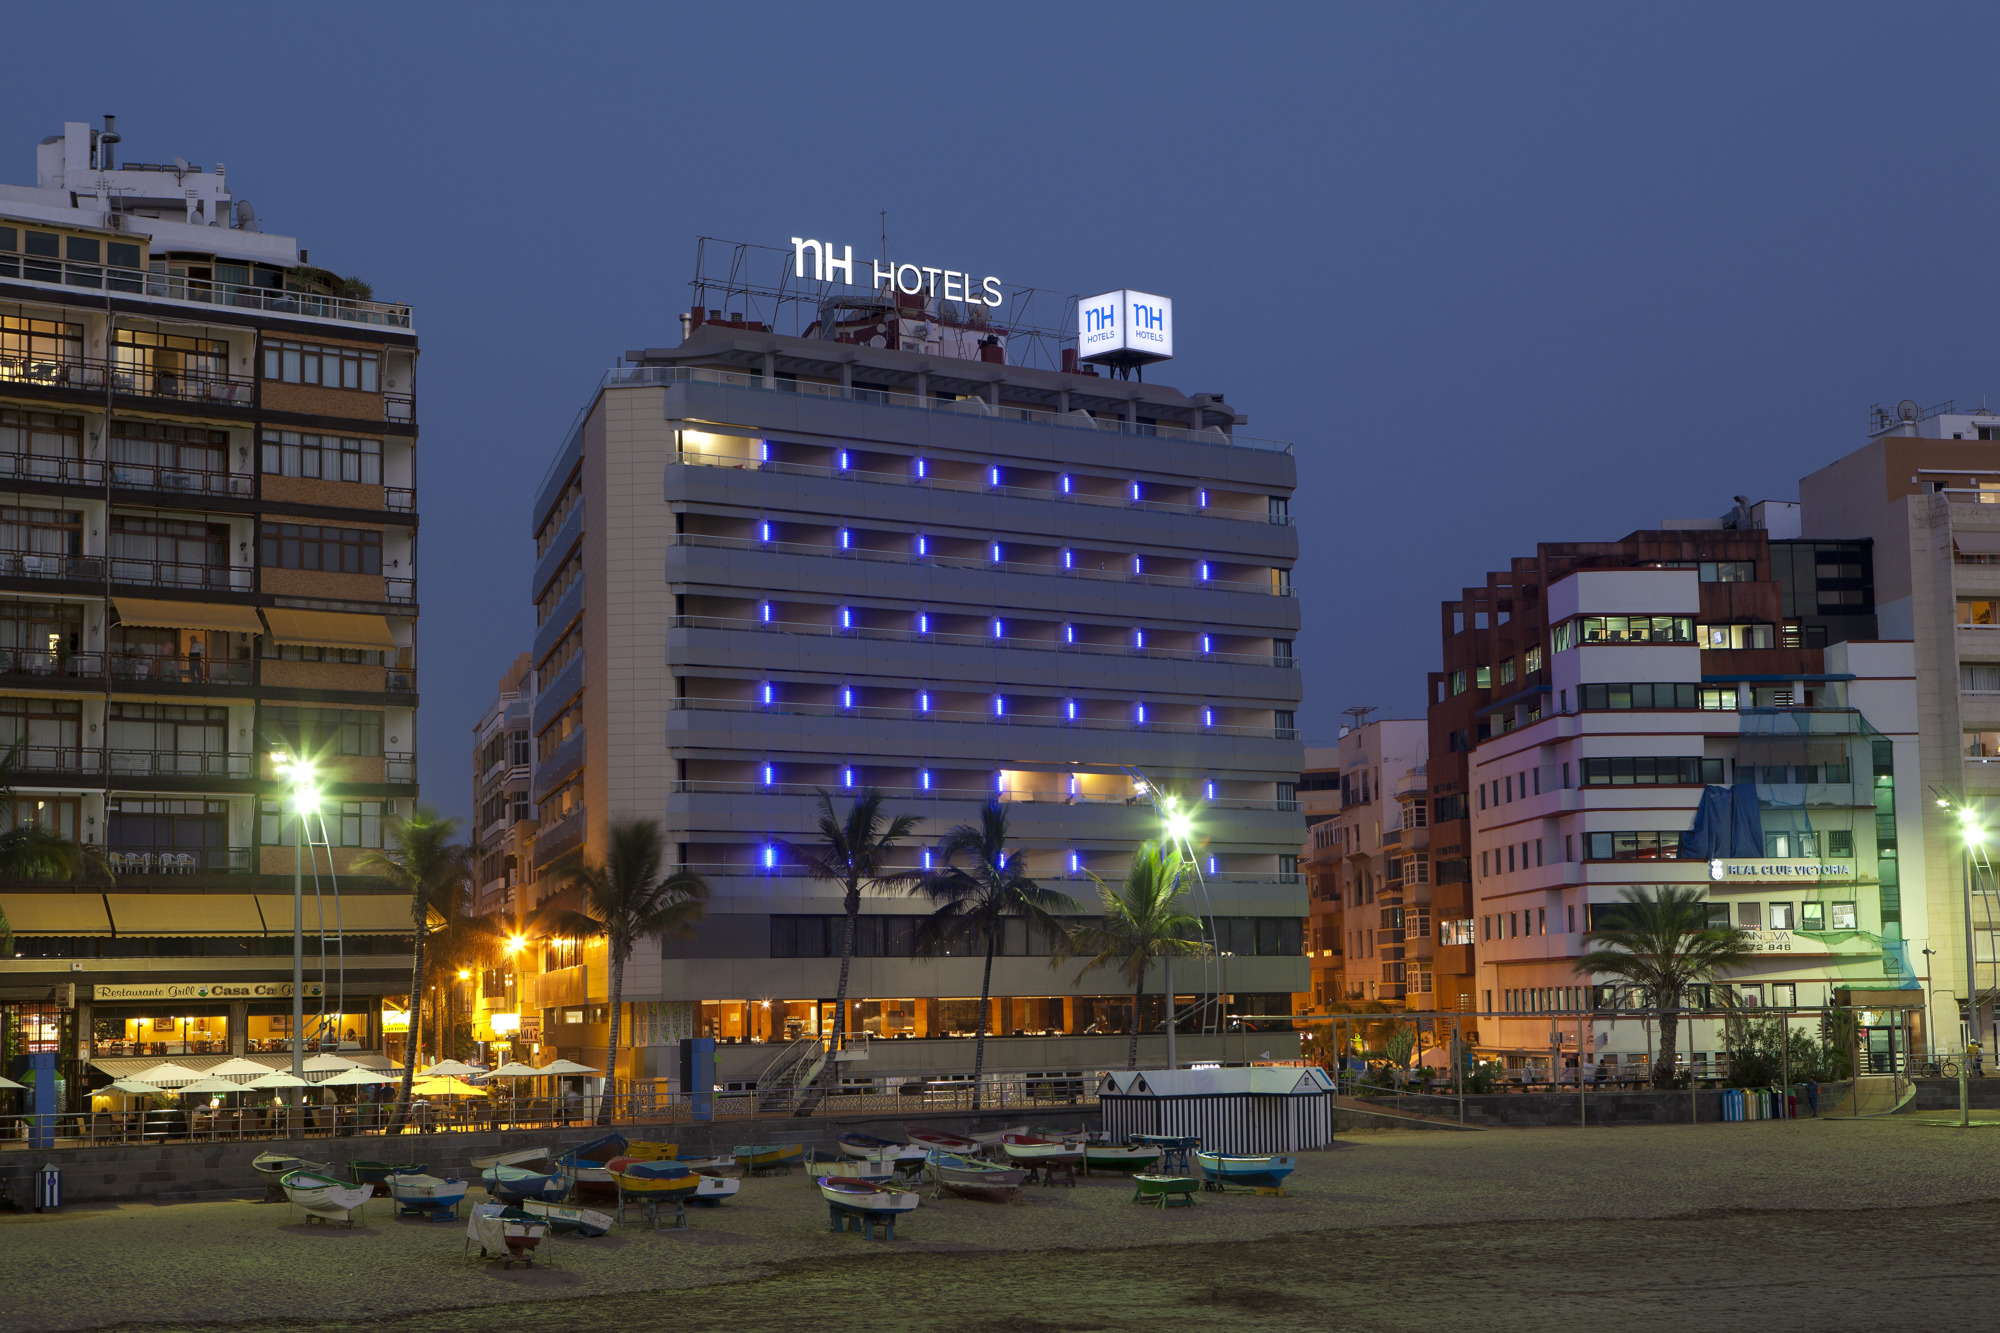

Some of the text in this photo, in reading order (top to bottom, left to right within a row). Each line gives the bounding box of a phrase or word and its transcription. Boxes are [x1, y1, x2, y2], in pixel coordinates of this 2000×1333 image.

[873, 259, 1003, 307] HOTELS
[1087, 330, 1115, 344] HOTELS
[1135, 329, 1164, 342] HOTELS
[1728, 865, 1850, 875] REAL CLUB VICTORIA
[96, 986, 164, 998] Restaurante
[168, 985, 195, 998] Grill
[211, 985, 250, 996] Casa
[520, 1028, 533, 1040] SALA
